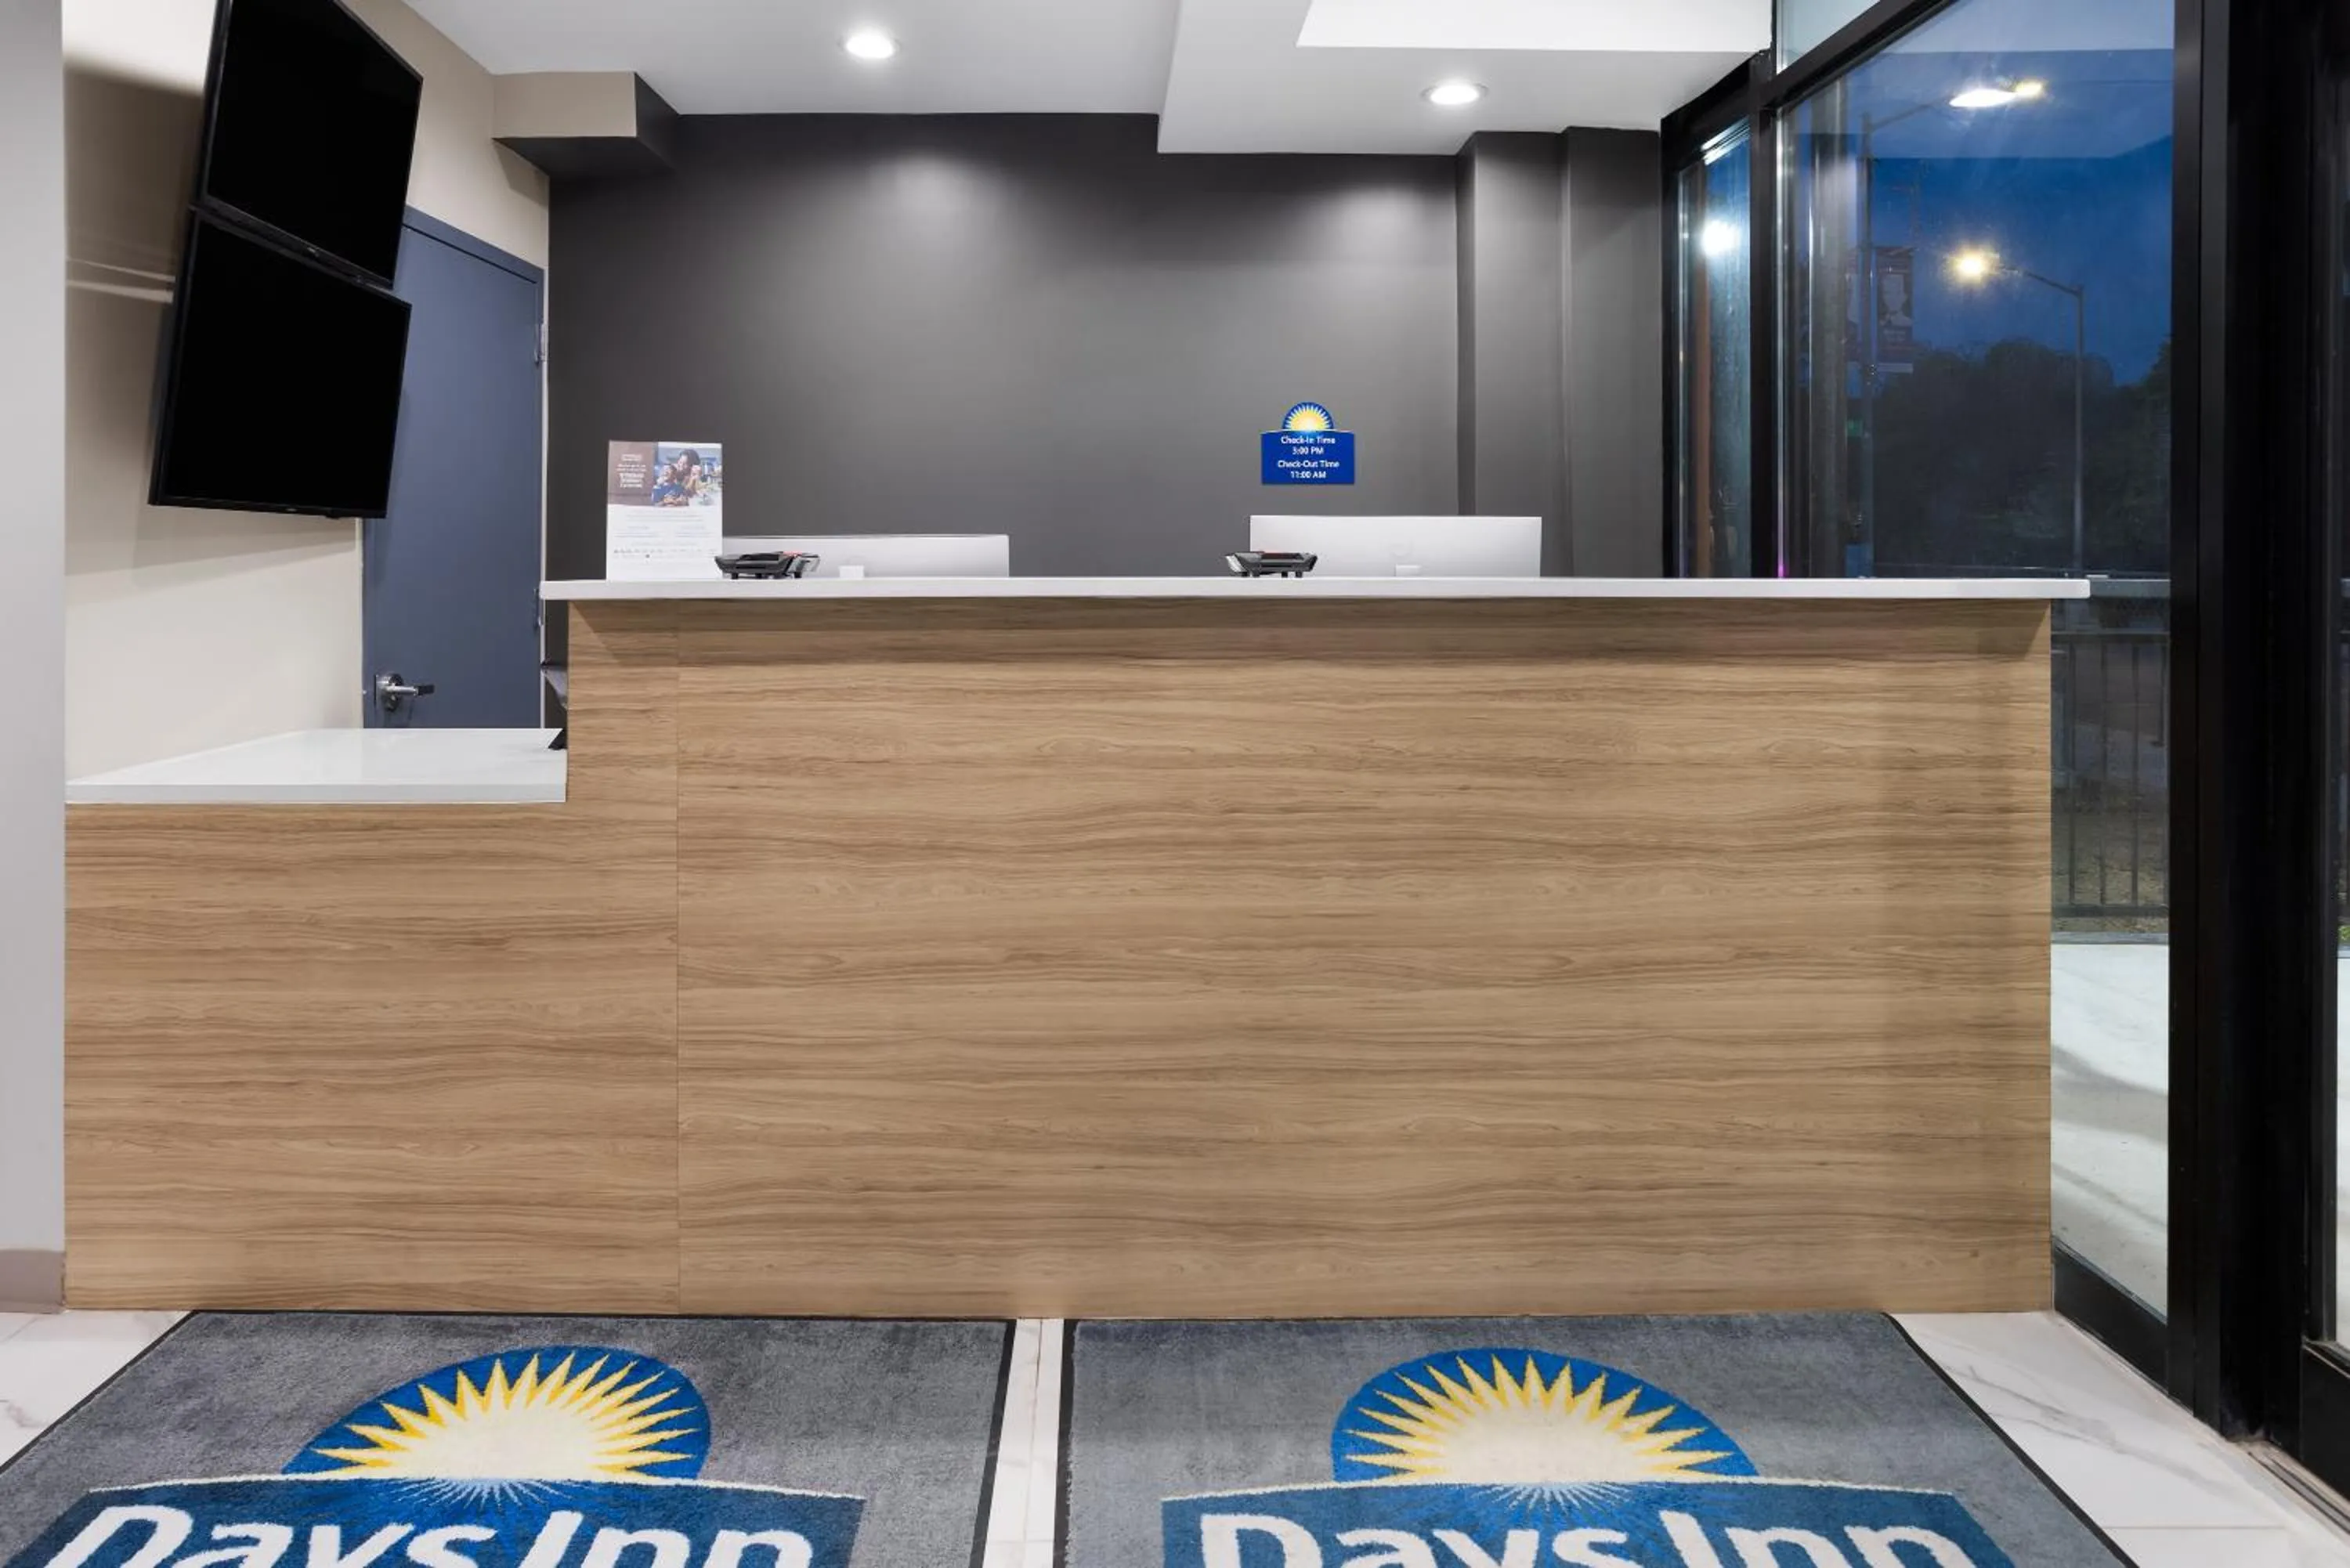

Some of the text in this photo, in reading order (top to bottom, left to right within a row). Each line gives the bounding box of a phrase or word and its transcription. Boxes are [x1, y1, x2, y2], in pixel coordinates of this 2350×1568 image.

[1281, 435, 1336, 444] Check-In Time
[1311, 446, 1324, 455] PM
